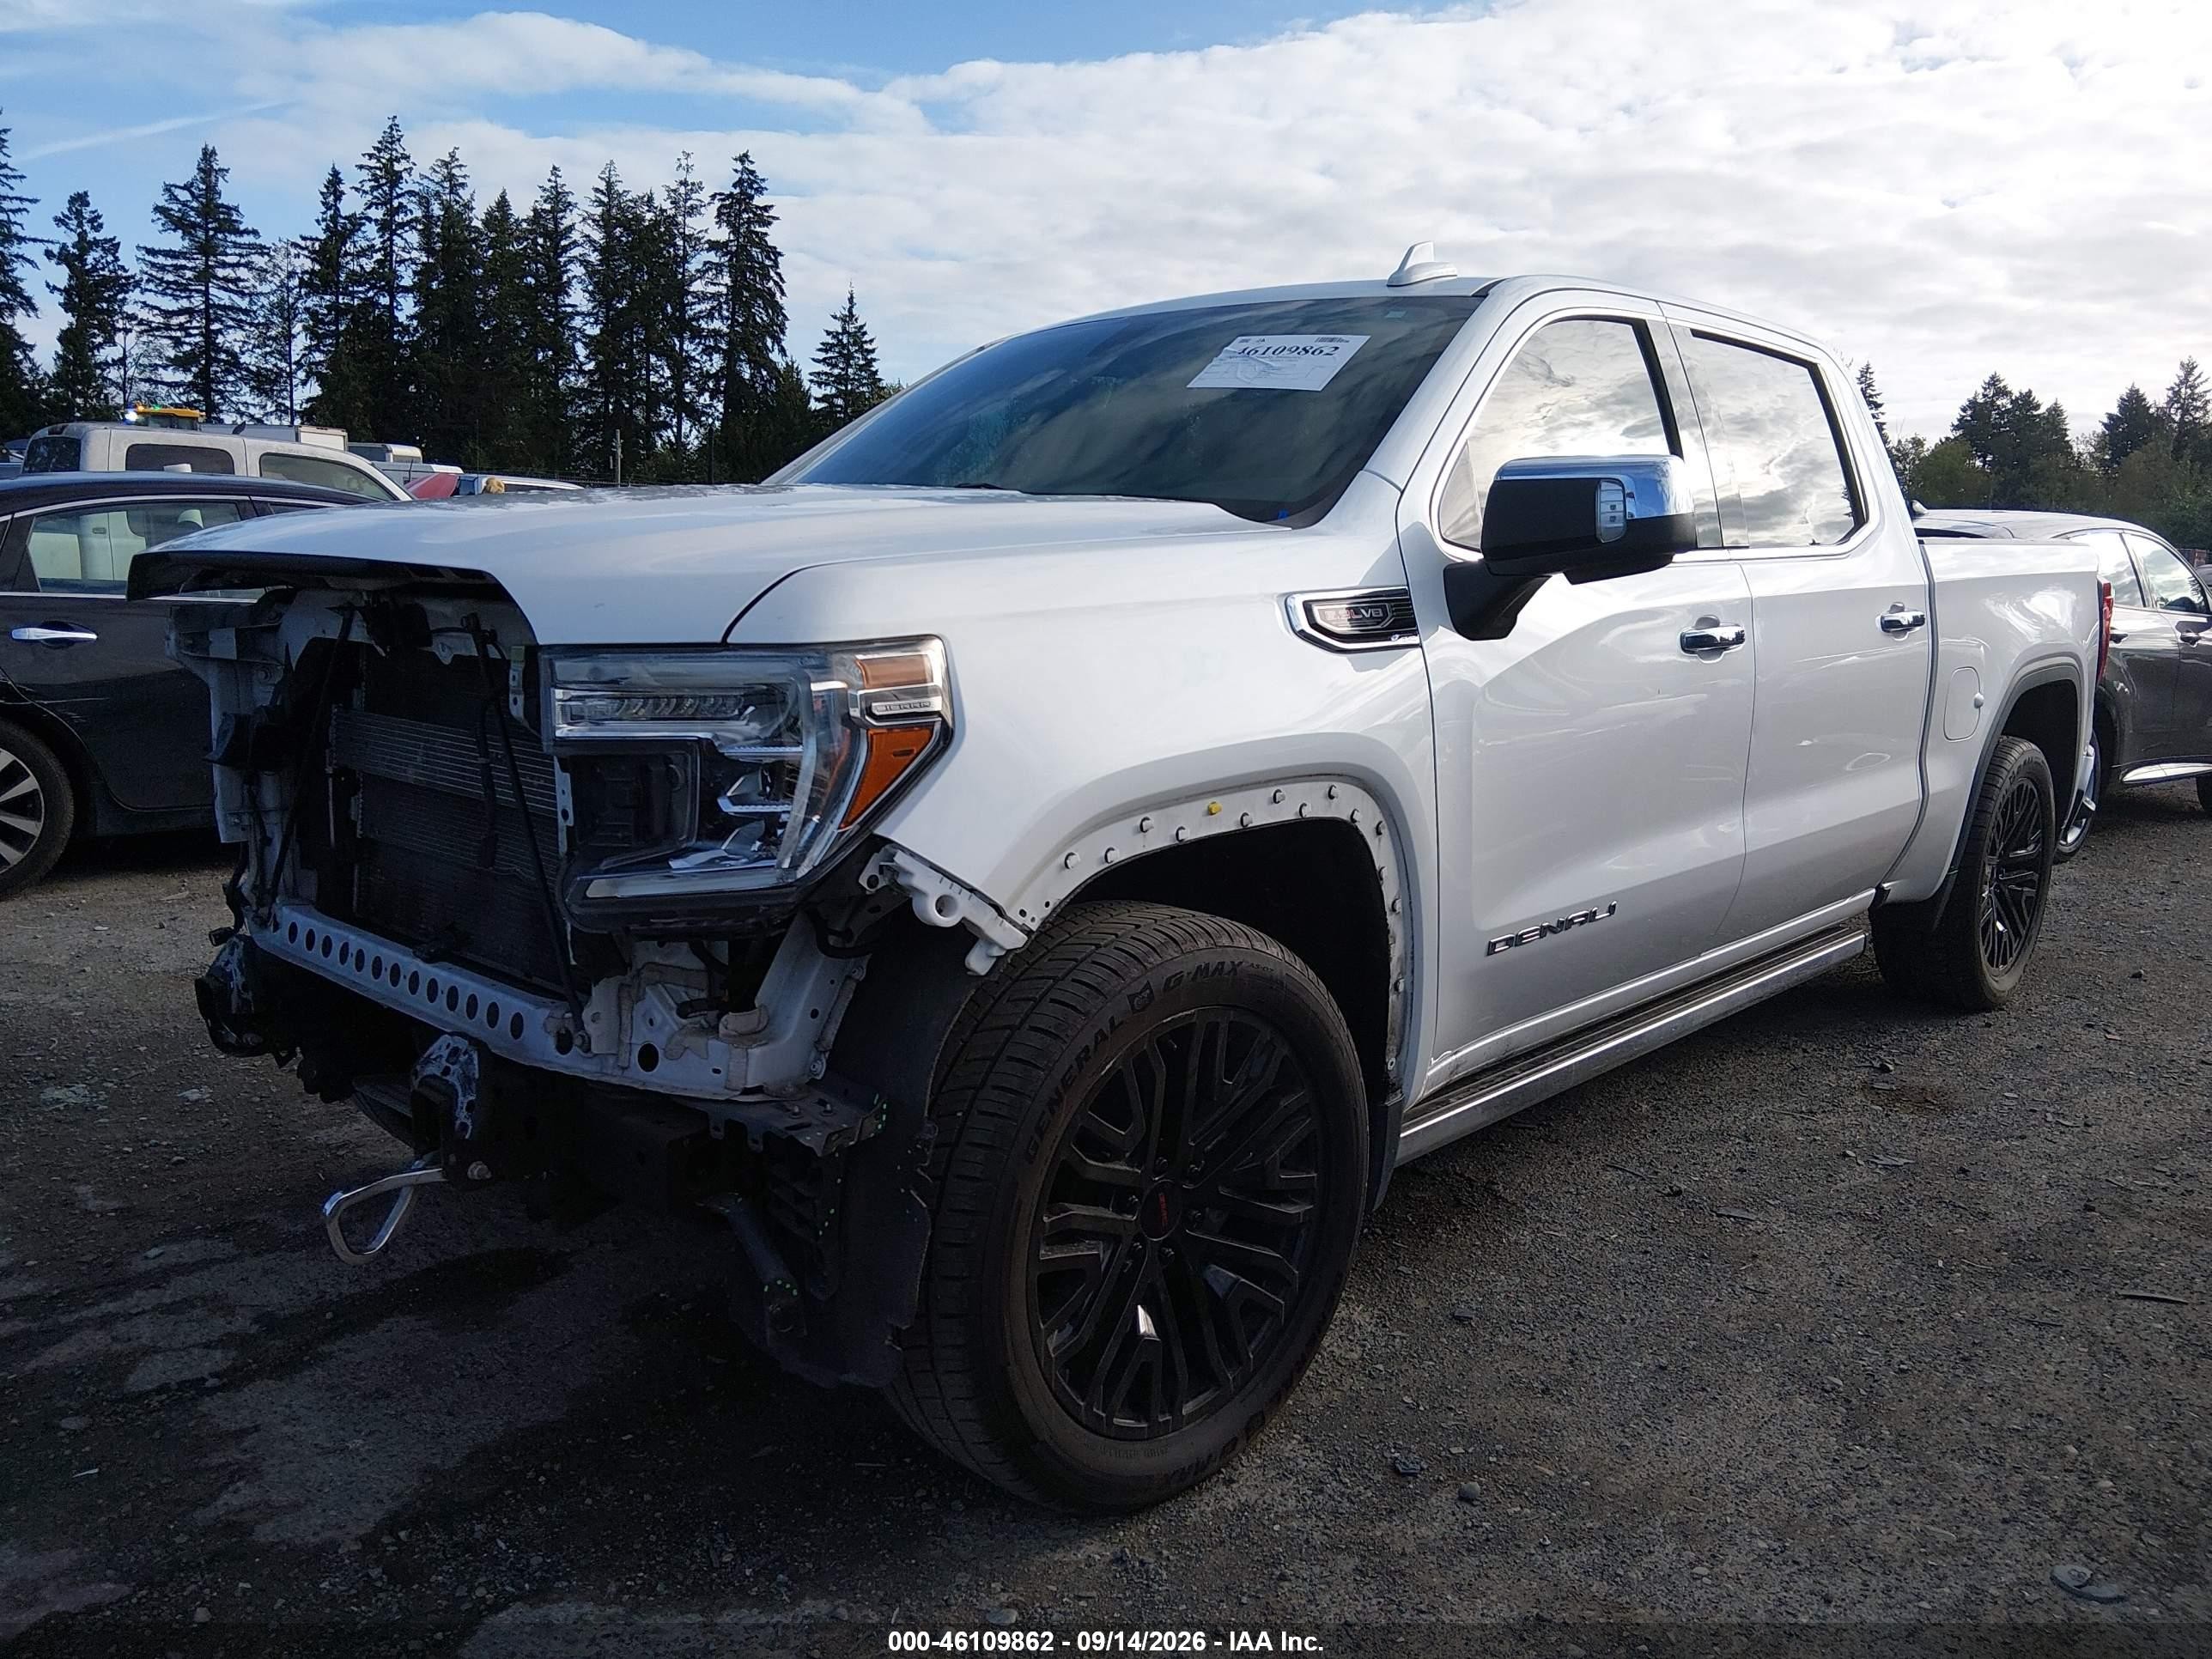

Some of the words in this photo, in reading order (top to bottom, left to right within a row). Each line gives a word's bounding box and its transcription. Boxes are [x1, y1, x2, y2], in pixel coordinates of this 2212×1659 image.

[876, 701, 931, 712] SIERRA
[1486, 901, 1617, 957] DENALI
[1026, 1016, 1123, 1157] GENERAL
